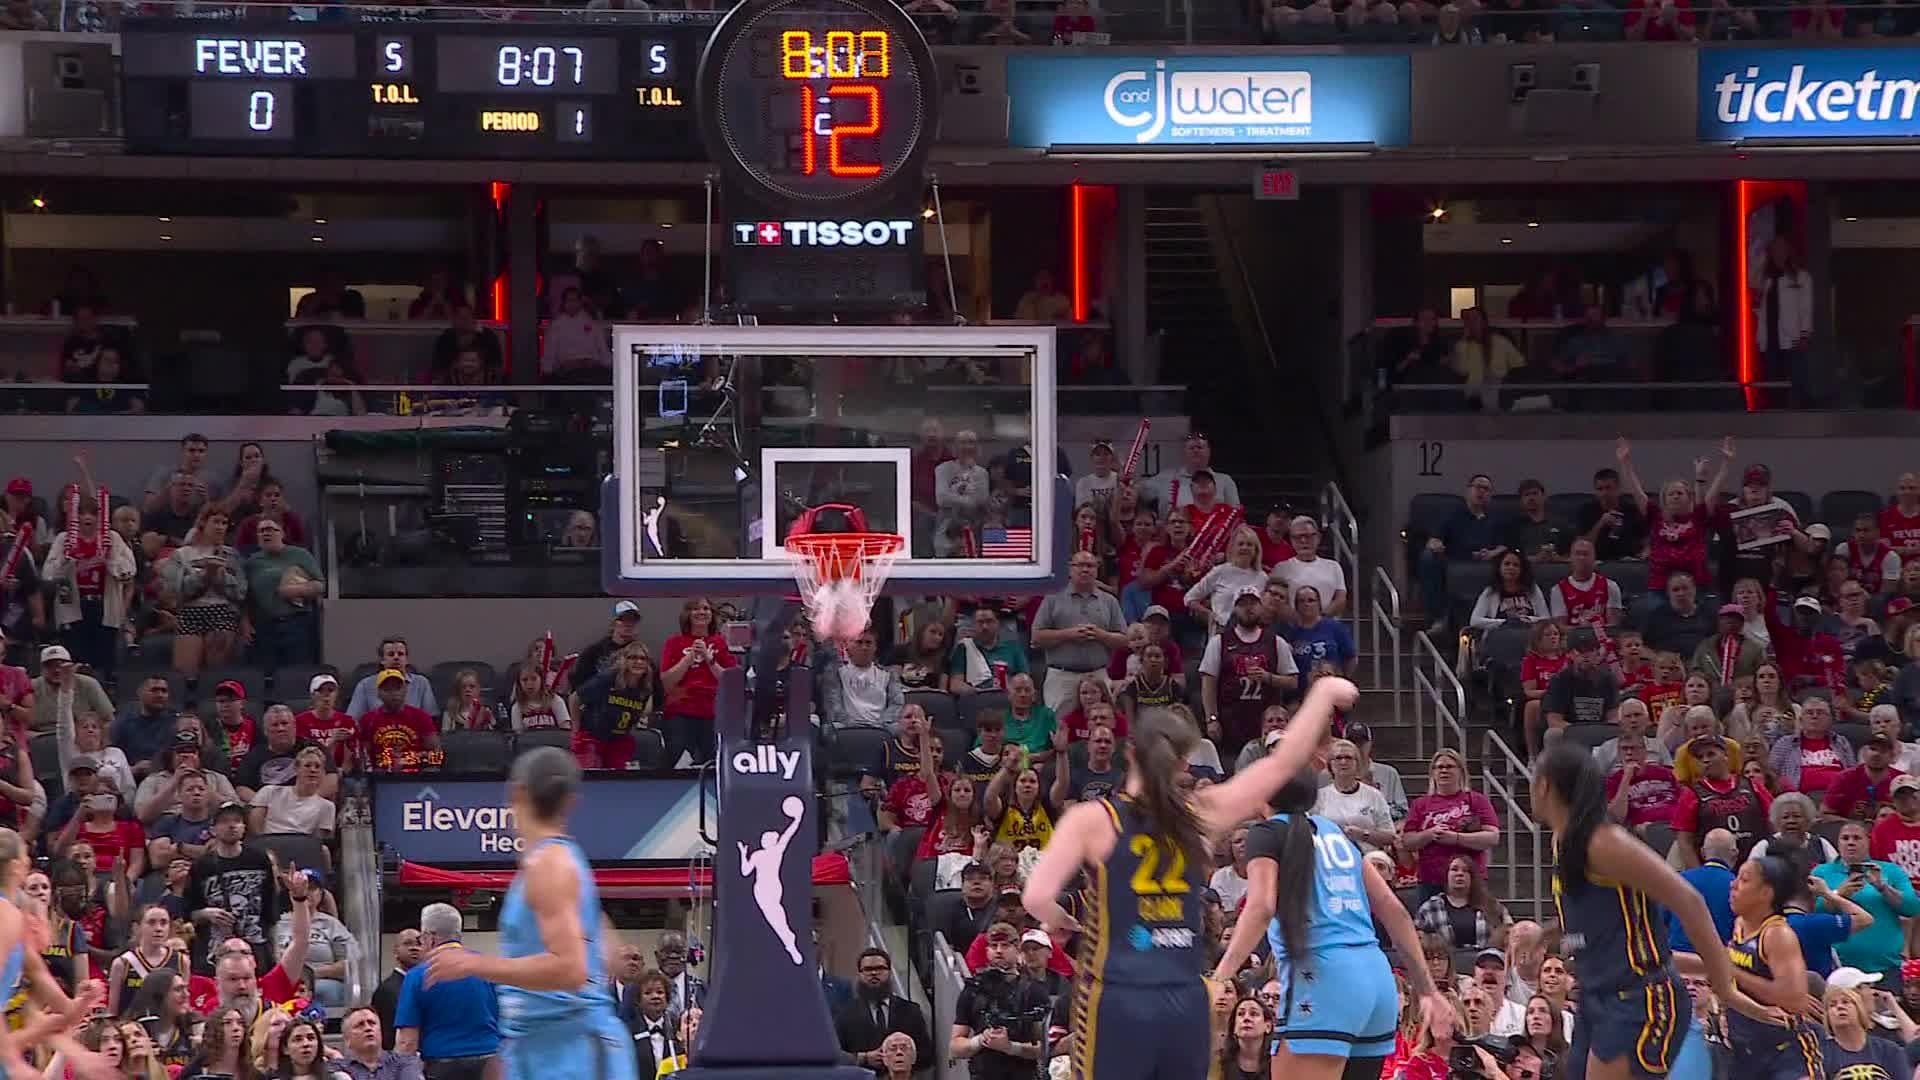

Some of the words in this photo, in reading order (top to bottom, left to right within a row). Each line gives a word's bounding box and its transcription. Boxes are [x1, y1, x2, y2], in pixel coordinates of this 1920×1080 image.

[196, 39, 306, 74] FEVER
[498, 46, 583, 85] 8:07
[371, 84, 419, 103] T.O.L.
[636, 87, 681, 106] T.O.L.
[1177, 77, 1305, 115] water
[250, 91, 273, 131] 0
[482, 112, 540, 131] PERIOD
[575, 110, 584, 134] 1
[801, 85, 881, 177] 12
[1246, 126, 1312, 137] TREATMENT
[784, 221, 913, 245] TISSOT
[1418, 441, 1443, 476] 12
[1240, 676, 1262, 700] 22
[733, 745, 800, 779] ally
[403, 801, 518, 831] Elevan
[481, 834, 528, 853] Hea
[1313, 833, 1355, 869] 10
[1129, 833, 1191, 894] 22
